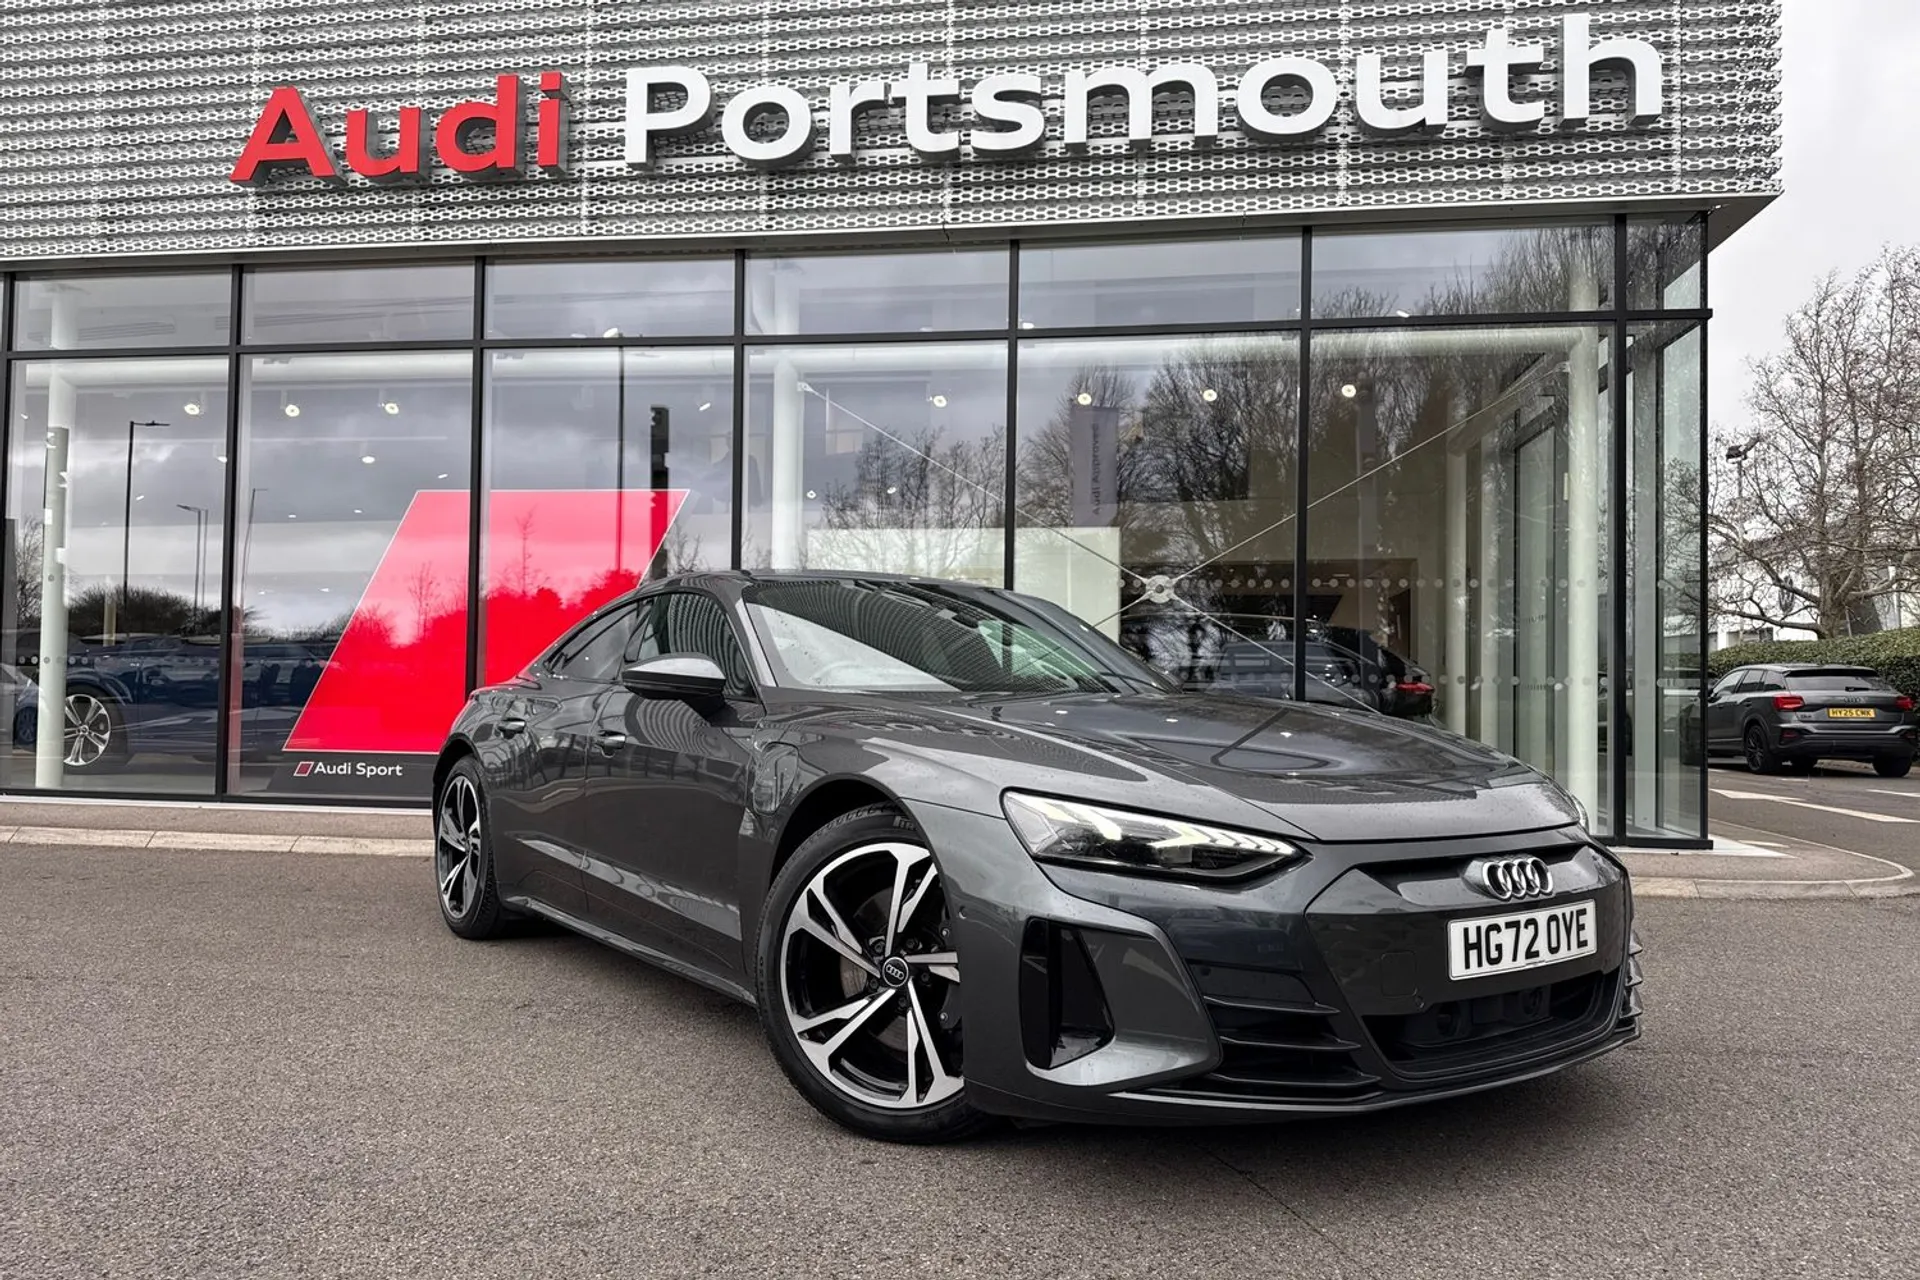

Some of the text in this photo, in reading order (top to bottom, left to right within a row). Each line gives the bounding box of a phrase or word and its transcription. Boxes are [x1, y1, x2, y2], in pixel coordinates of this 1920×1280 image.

[229, 13, 1663, 184] Audi Portsmouth
[314, 762, 403, 778] Audi Sport
[1463, 908, 1588, 970] HG72 OYE
